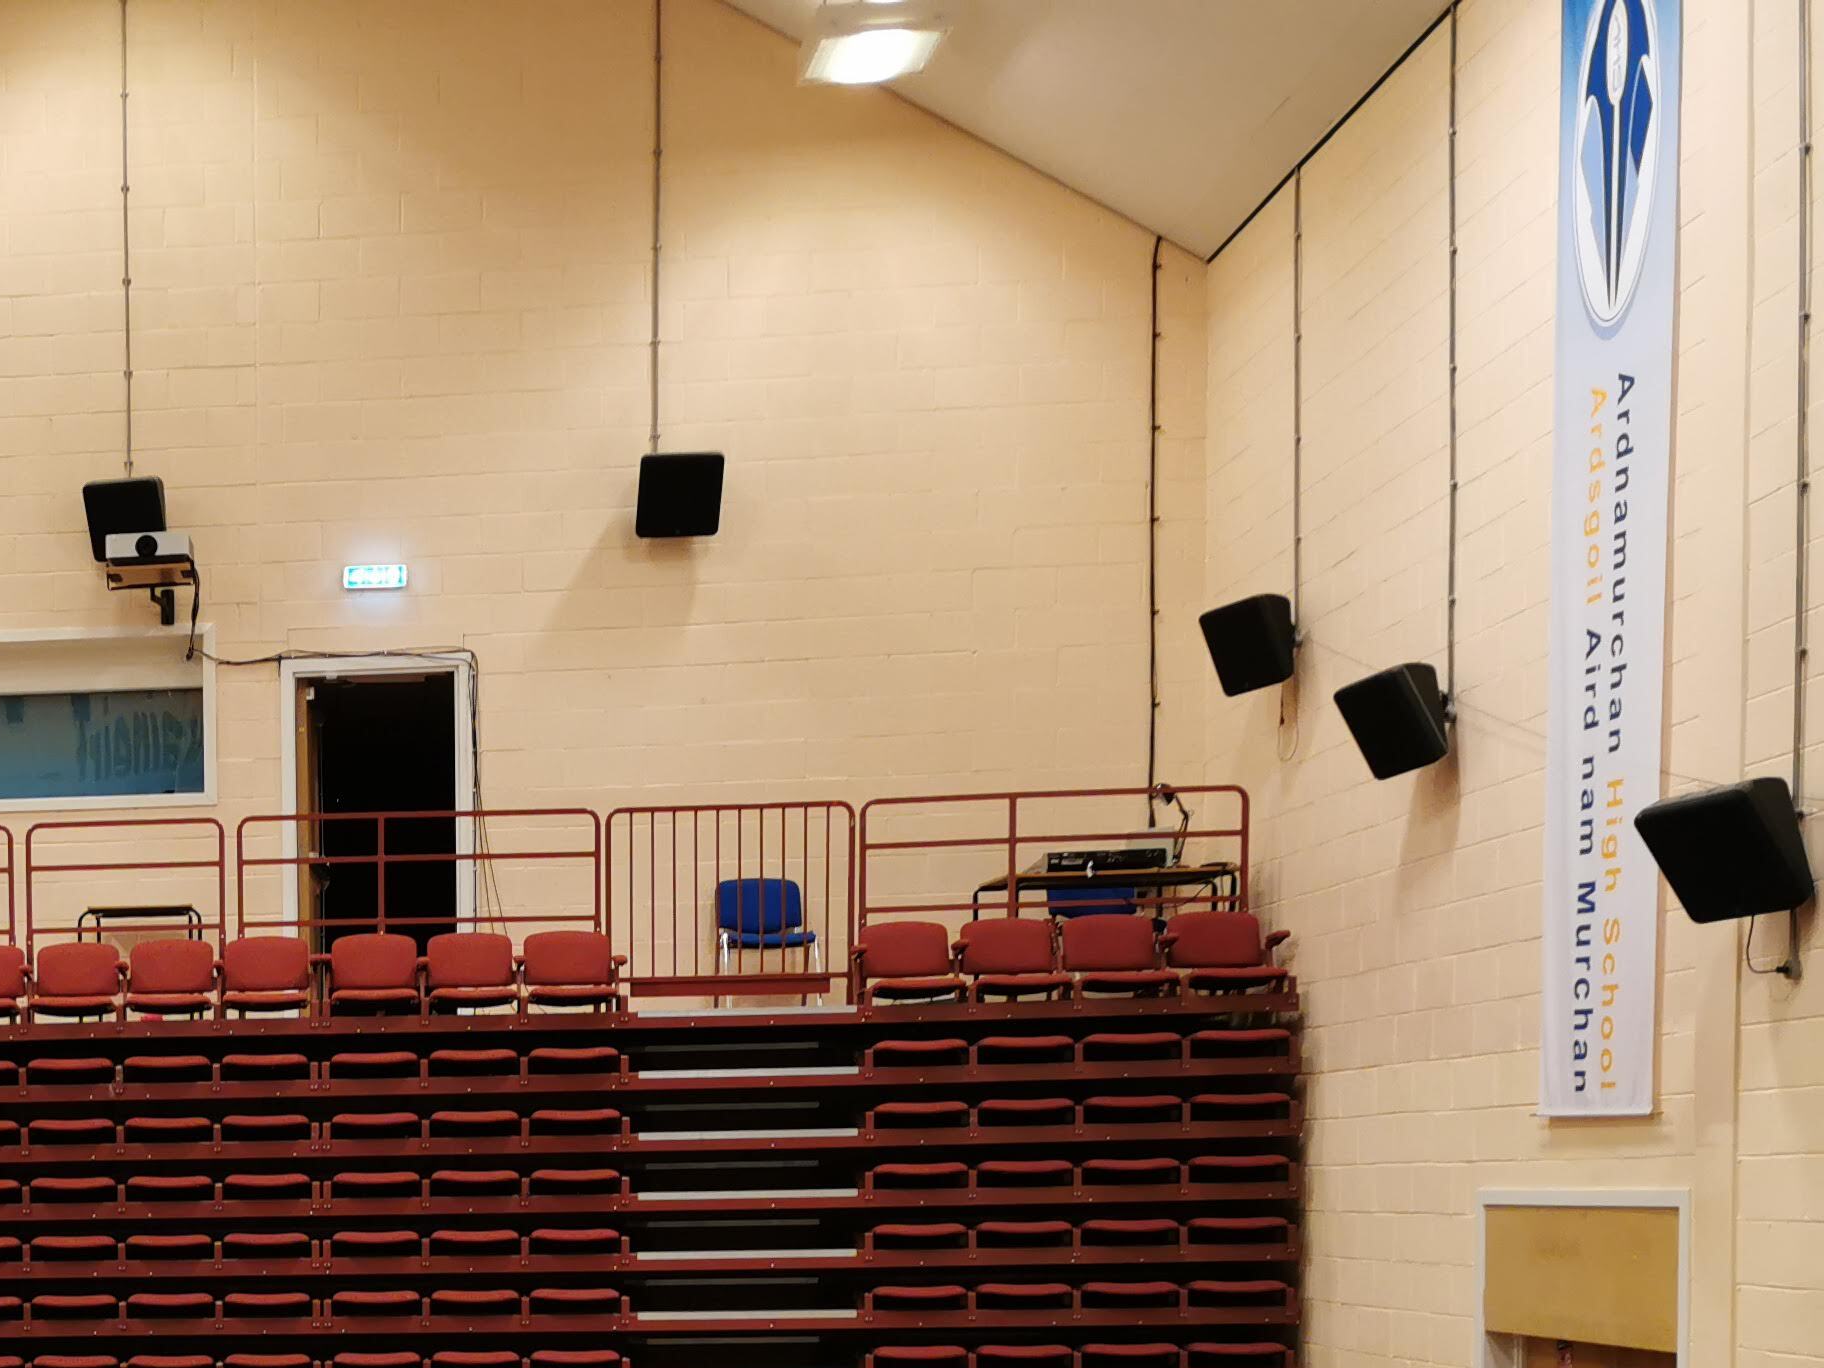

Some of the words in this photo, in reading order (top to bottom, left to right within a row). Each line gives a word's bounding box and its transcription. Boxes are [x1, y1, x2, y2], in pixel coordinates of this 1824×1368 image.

[1583, 386, 1609, 606] Ardsgoil
[1608, 372, 1635, 756] Ardnamurchan
[1583, 628, 1602, 731] Aird
[1580, 755, 1594, 857] nam
[1600, 777, 1625, 895] High
[1572, 880, 1596, 1093] Murchan
[1599, 916, 1622, 1091] School
